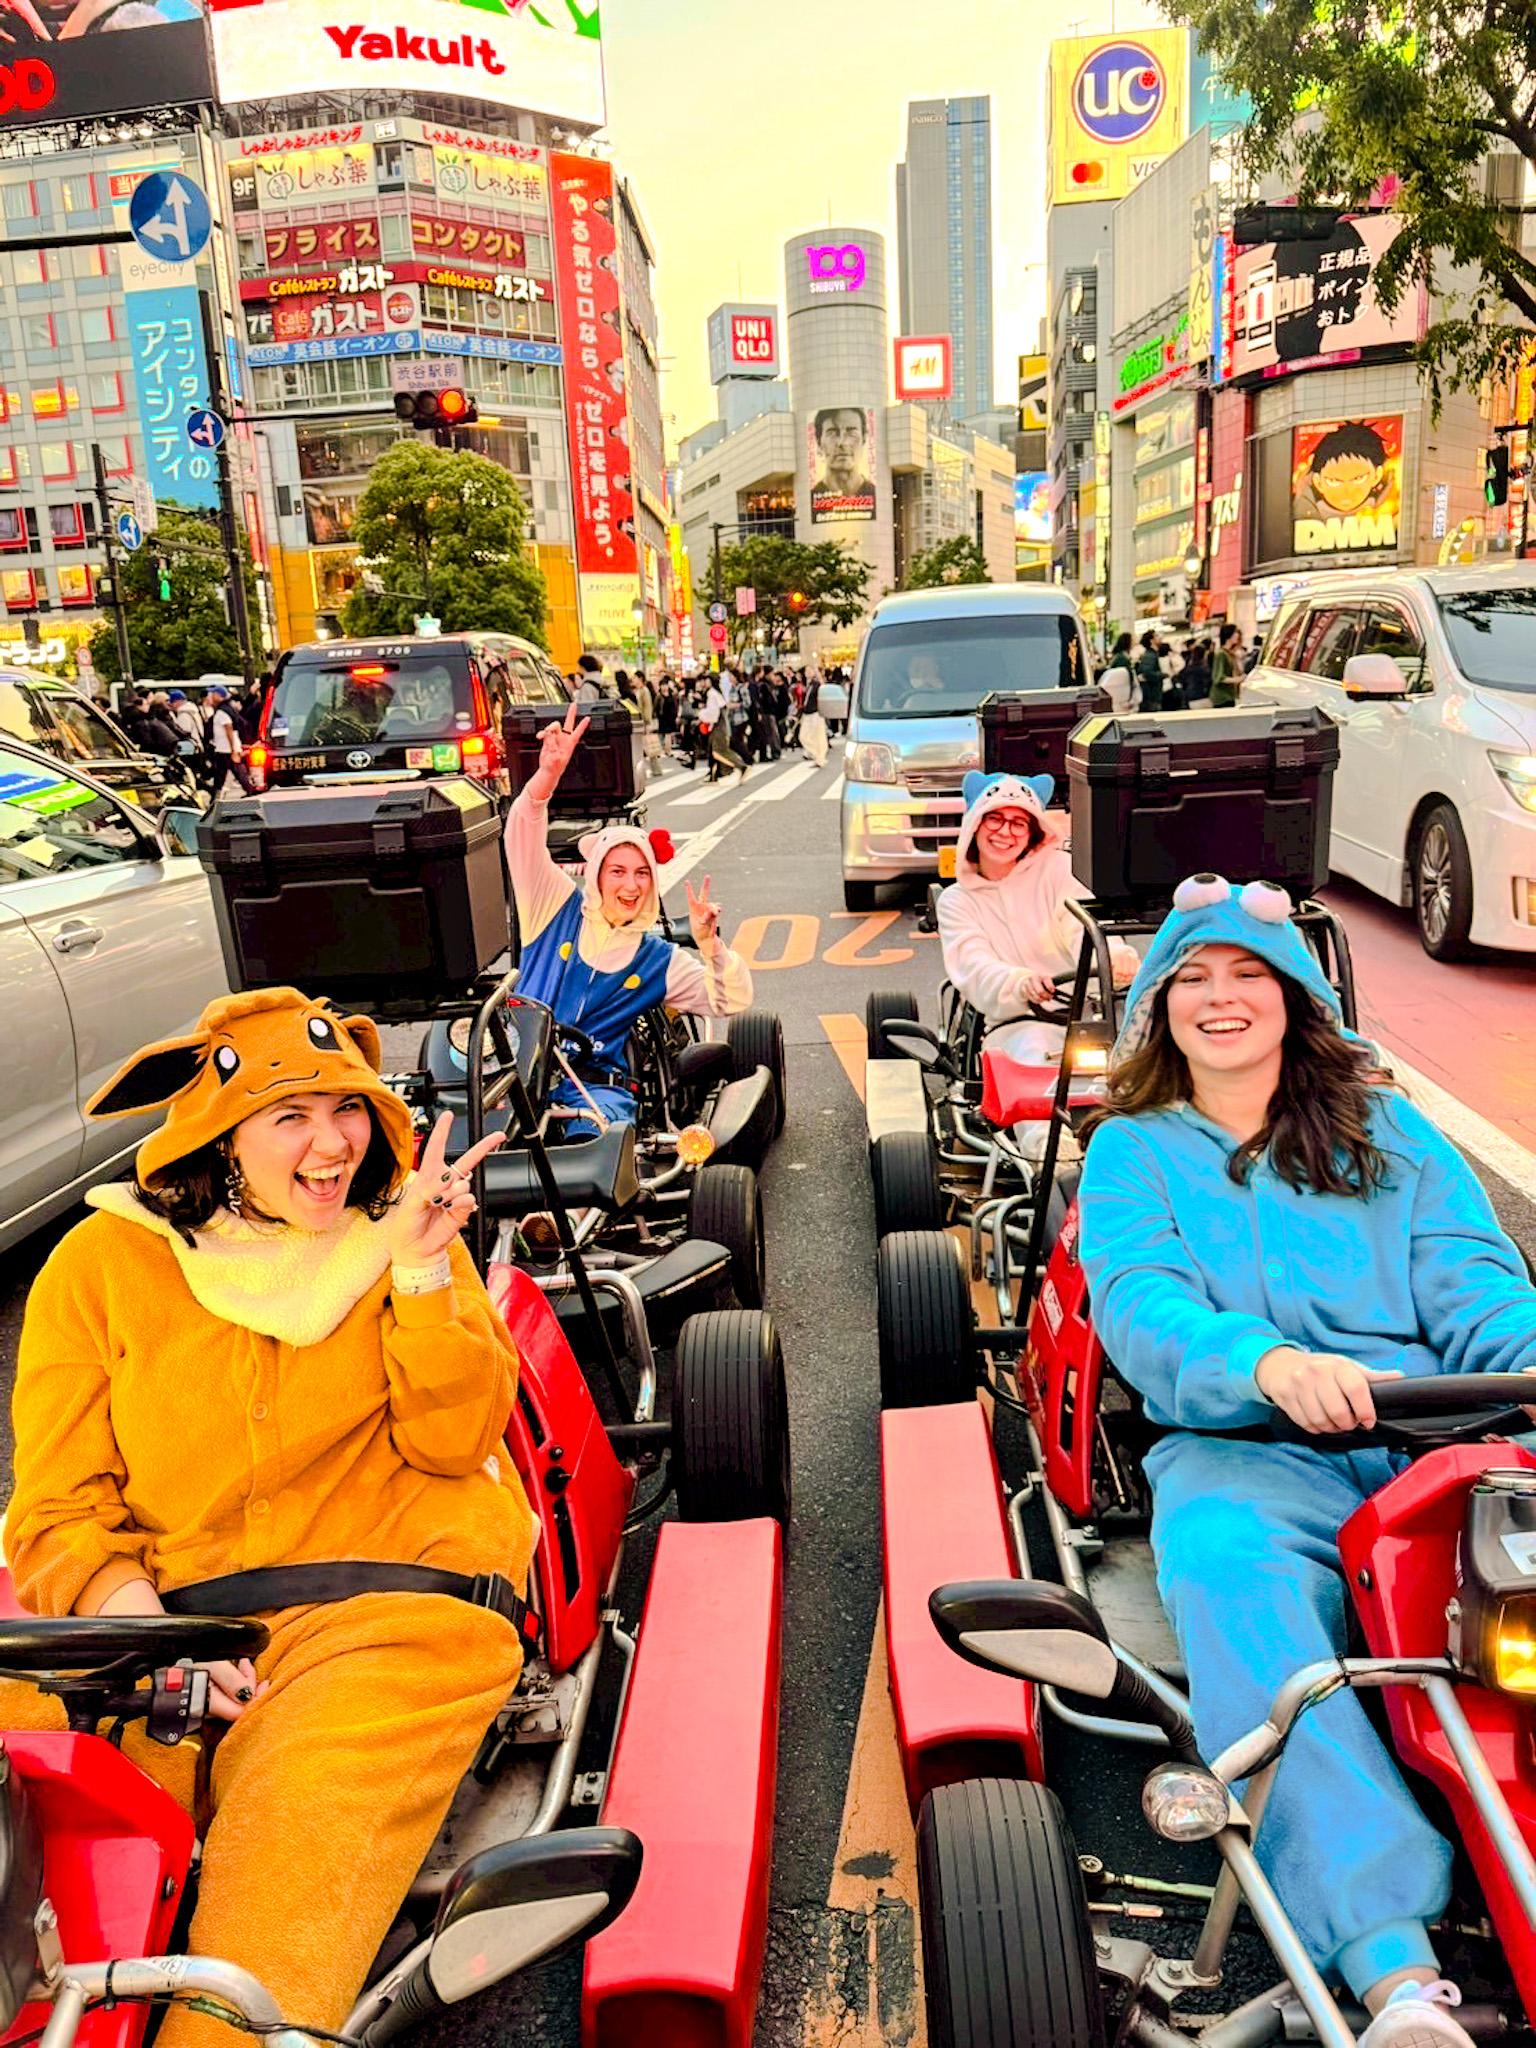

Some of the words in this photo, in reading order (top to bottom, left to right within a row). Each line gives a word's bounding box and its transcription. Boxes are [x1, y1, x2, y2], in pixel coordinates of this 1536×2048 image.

[323, 25, 507, 75] Yakult
[240, 125, 364, 156] しゃぶしゃぶバイキング
[422, 124, 540, 162] しゃぶしゃぶバイキング
[232, 176, 255, 197] 9F
[297, 156, 370, 190] しゃぶ葉
[473, 165, 541, 200] しゃぶ葉
[266, 220, 379, 260] プライス
[411, 219, 526, 260] コンタクト
[806, 244, 866, 292] 109
[1317, 247, 1373, 274] 正規品
[338, 264, 395, 294] ガスト
[494, 273, 545, 302] ガスト
[809, 280, 846, 294] SHIBUYA
[247, 312, 274, 336] 7F
[311, 300, 378, 336] ガスト
[735, 319, 767, 338] UNI
[736, 339, 770, 360] QLO
[397, 362, 458, 380] 渋谷駅前
[136, 320, 184, 481] アイシティ
[1294, 514, 1396, 555] DMM
